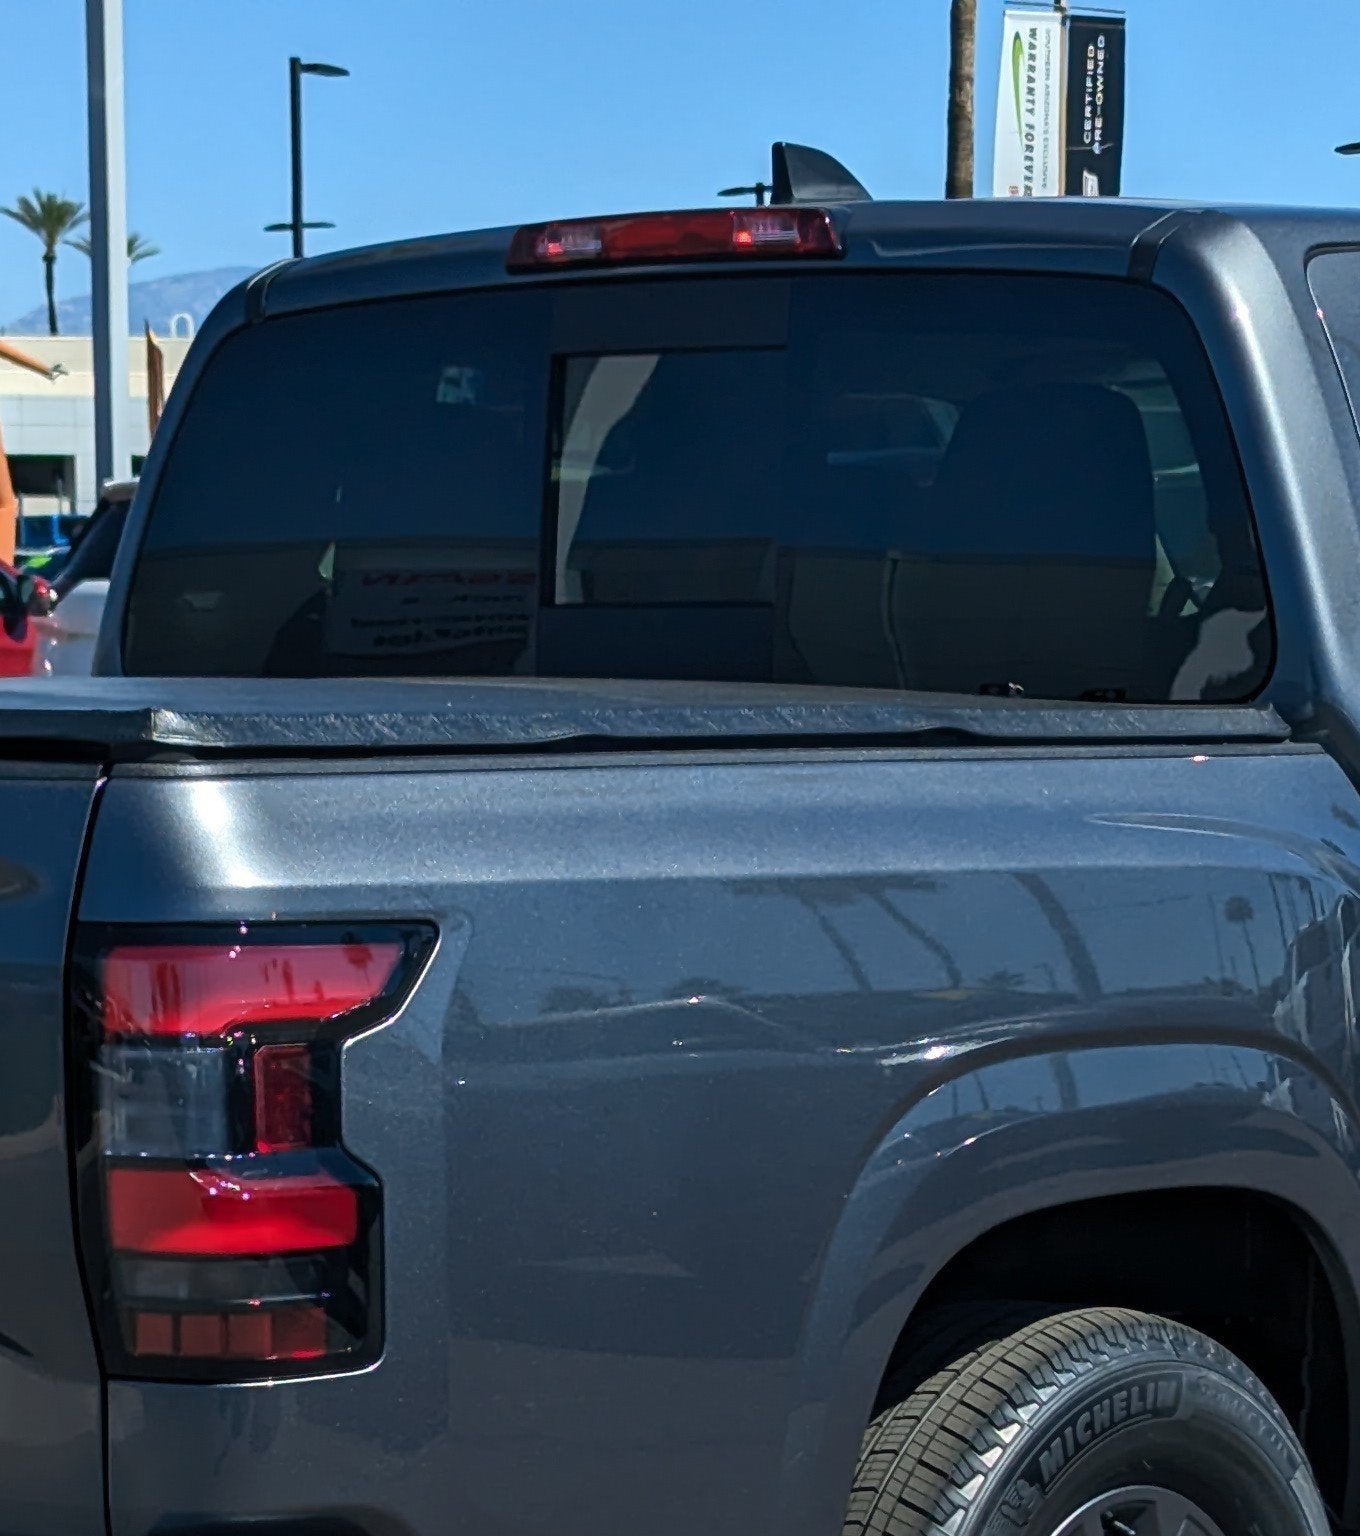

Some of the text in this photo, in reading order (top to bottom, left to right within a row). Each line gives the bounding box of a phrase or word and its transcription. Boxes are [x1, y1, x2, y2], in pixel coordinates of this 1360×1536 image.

[1025, 27, 1038, 117] WARRANTY
[1083, 44, 1095, 144] CERTIFIED
[1037, 1377, 1179, 1486] MICHELIN
